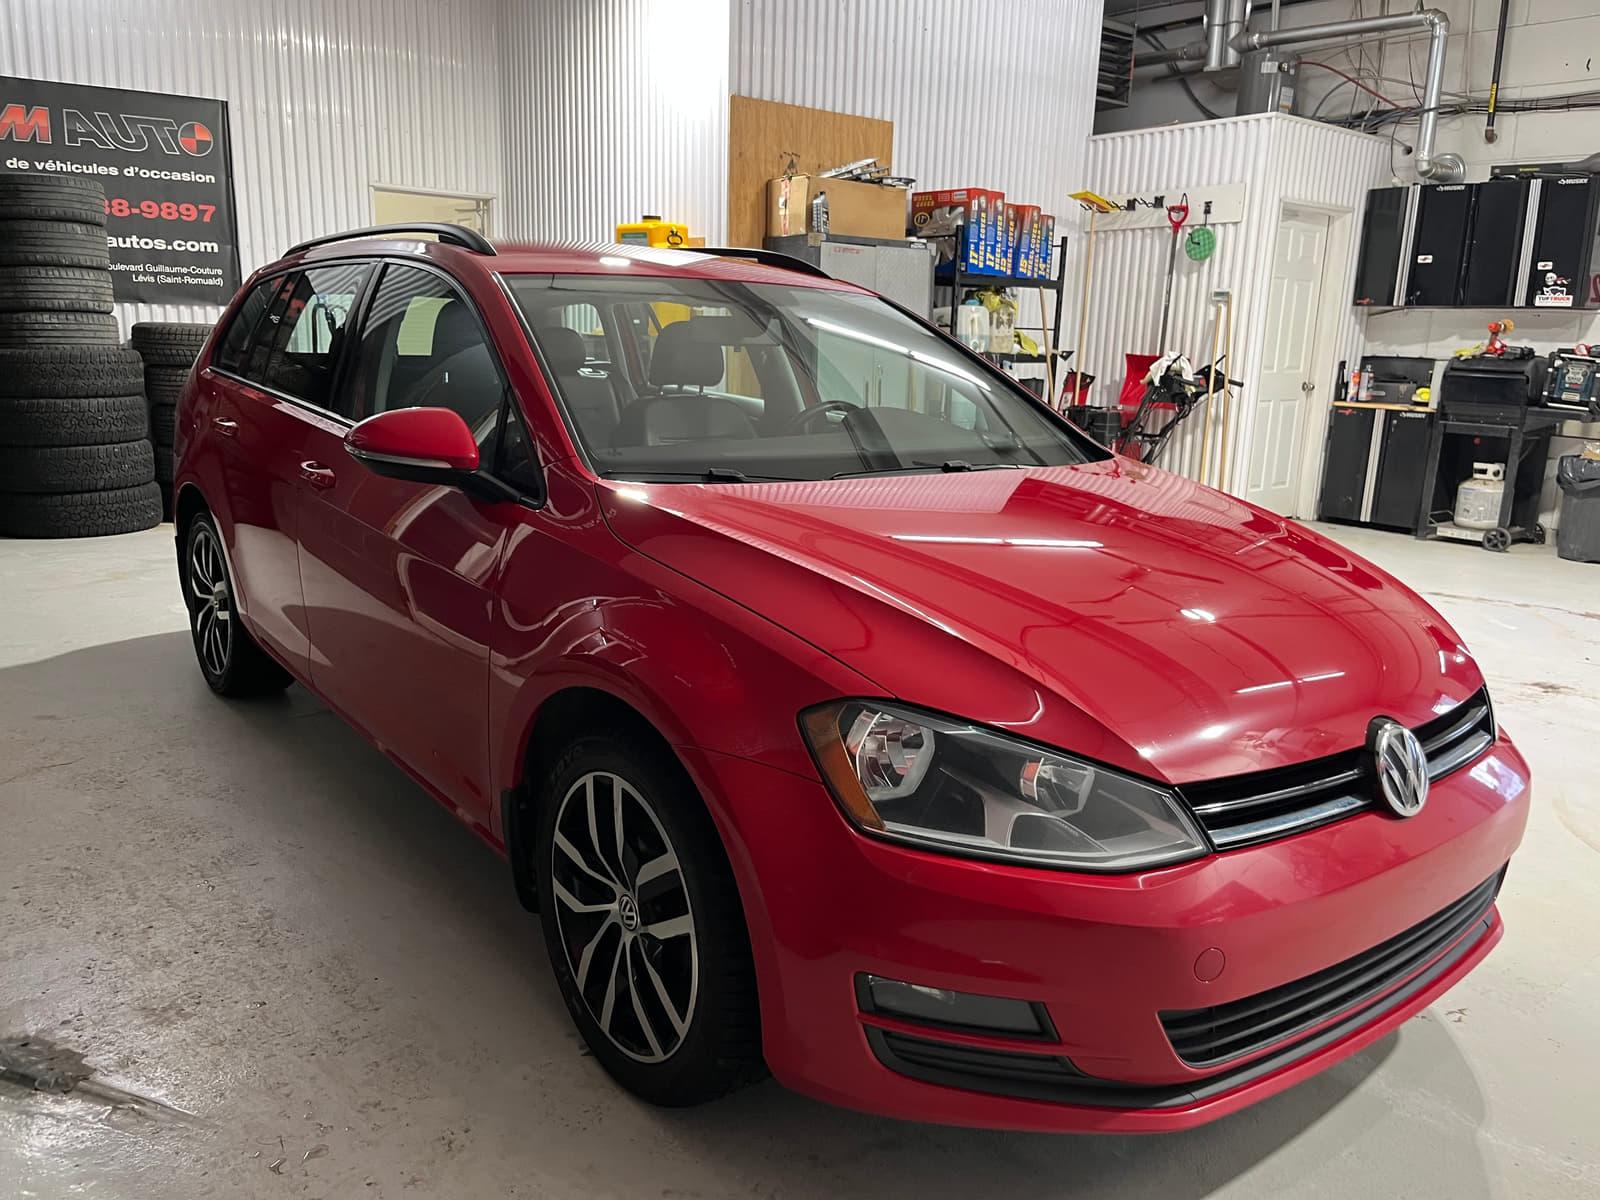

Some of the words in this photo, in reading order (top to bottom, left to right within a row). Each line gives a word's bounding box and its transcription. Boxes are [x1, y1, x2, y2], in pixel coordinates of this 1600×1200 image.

[6, 157, 29, 171] de
[35, 159, 119, 177] véhicules
[123, 166, 216, 184] d'occasion
[145, 263, 223, 275] Guillaume-Couture
[132, 273, 155, 283] Lévis
[157, 275, 224, 287] (Saint-Romuald)
